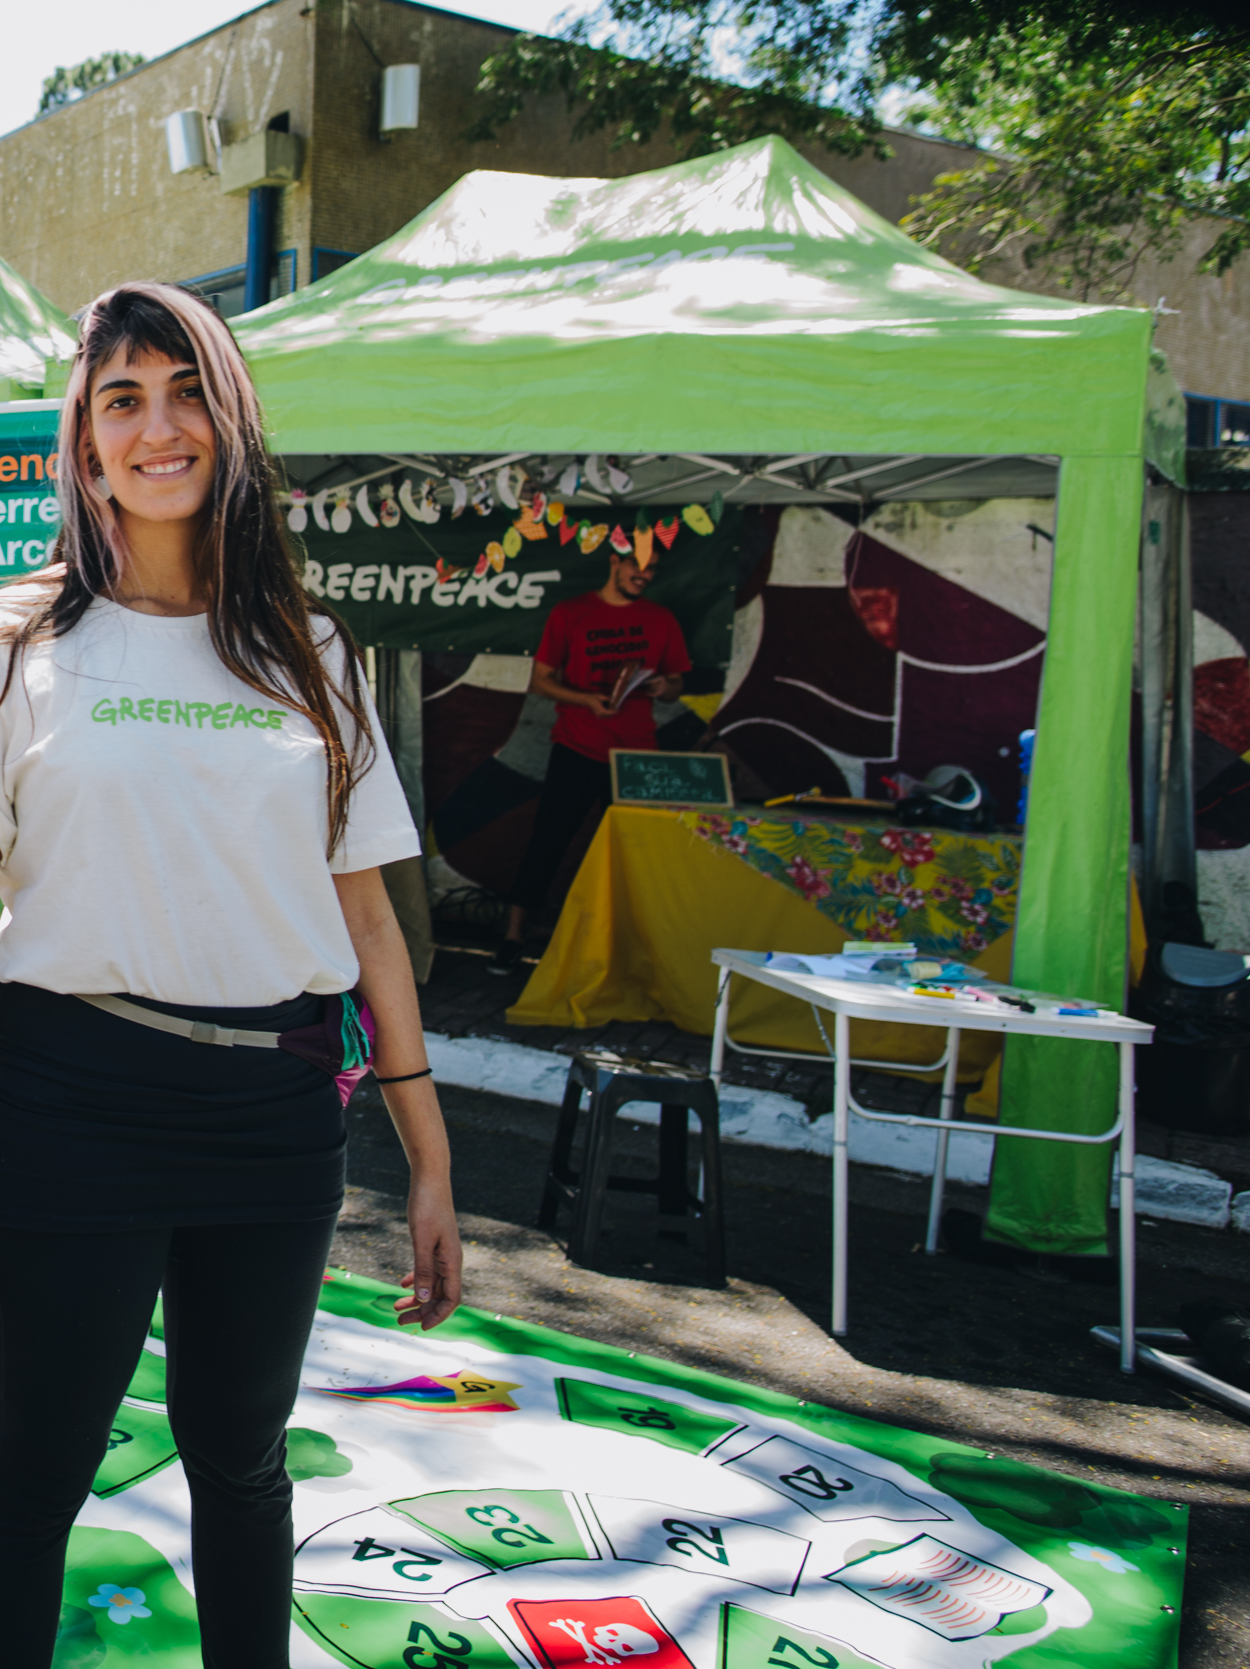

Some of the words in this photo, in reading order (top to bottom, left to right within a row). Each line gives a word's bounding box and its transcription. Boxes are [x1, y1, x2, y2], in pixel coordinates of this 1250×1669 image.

[91, 697, 289, 730] GREENPEACE
[617, 1406, 677, 1431] 19
[778, 1464, 855, 1501] 20
[465, 1504, 555, 1548] 23
[661, 1518, 730, 1566] 22
[352, 1537, 443, 1581] 24
